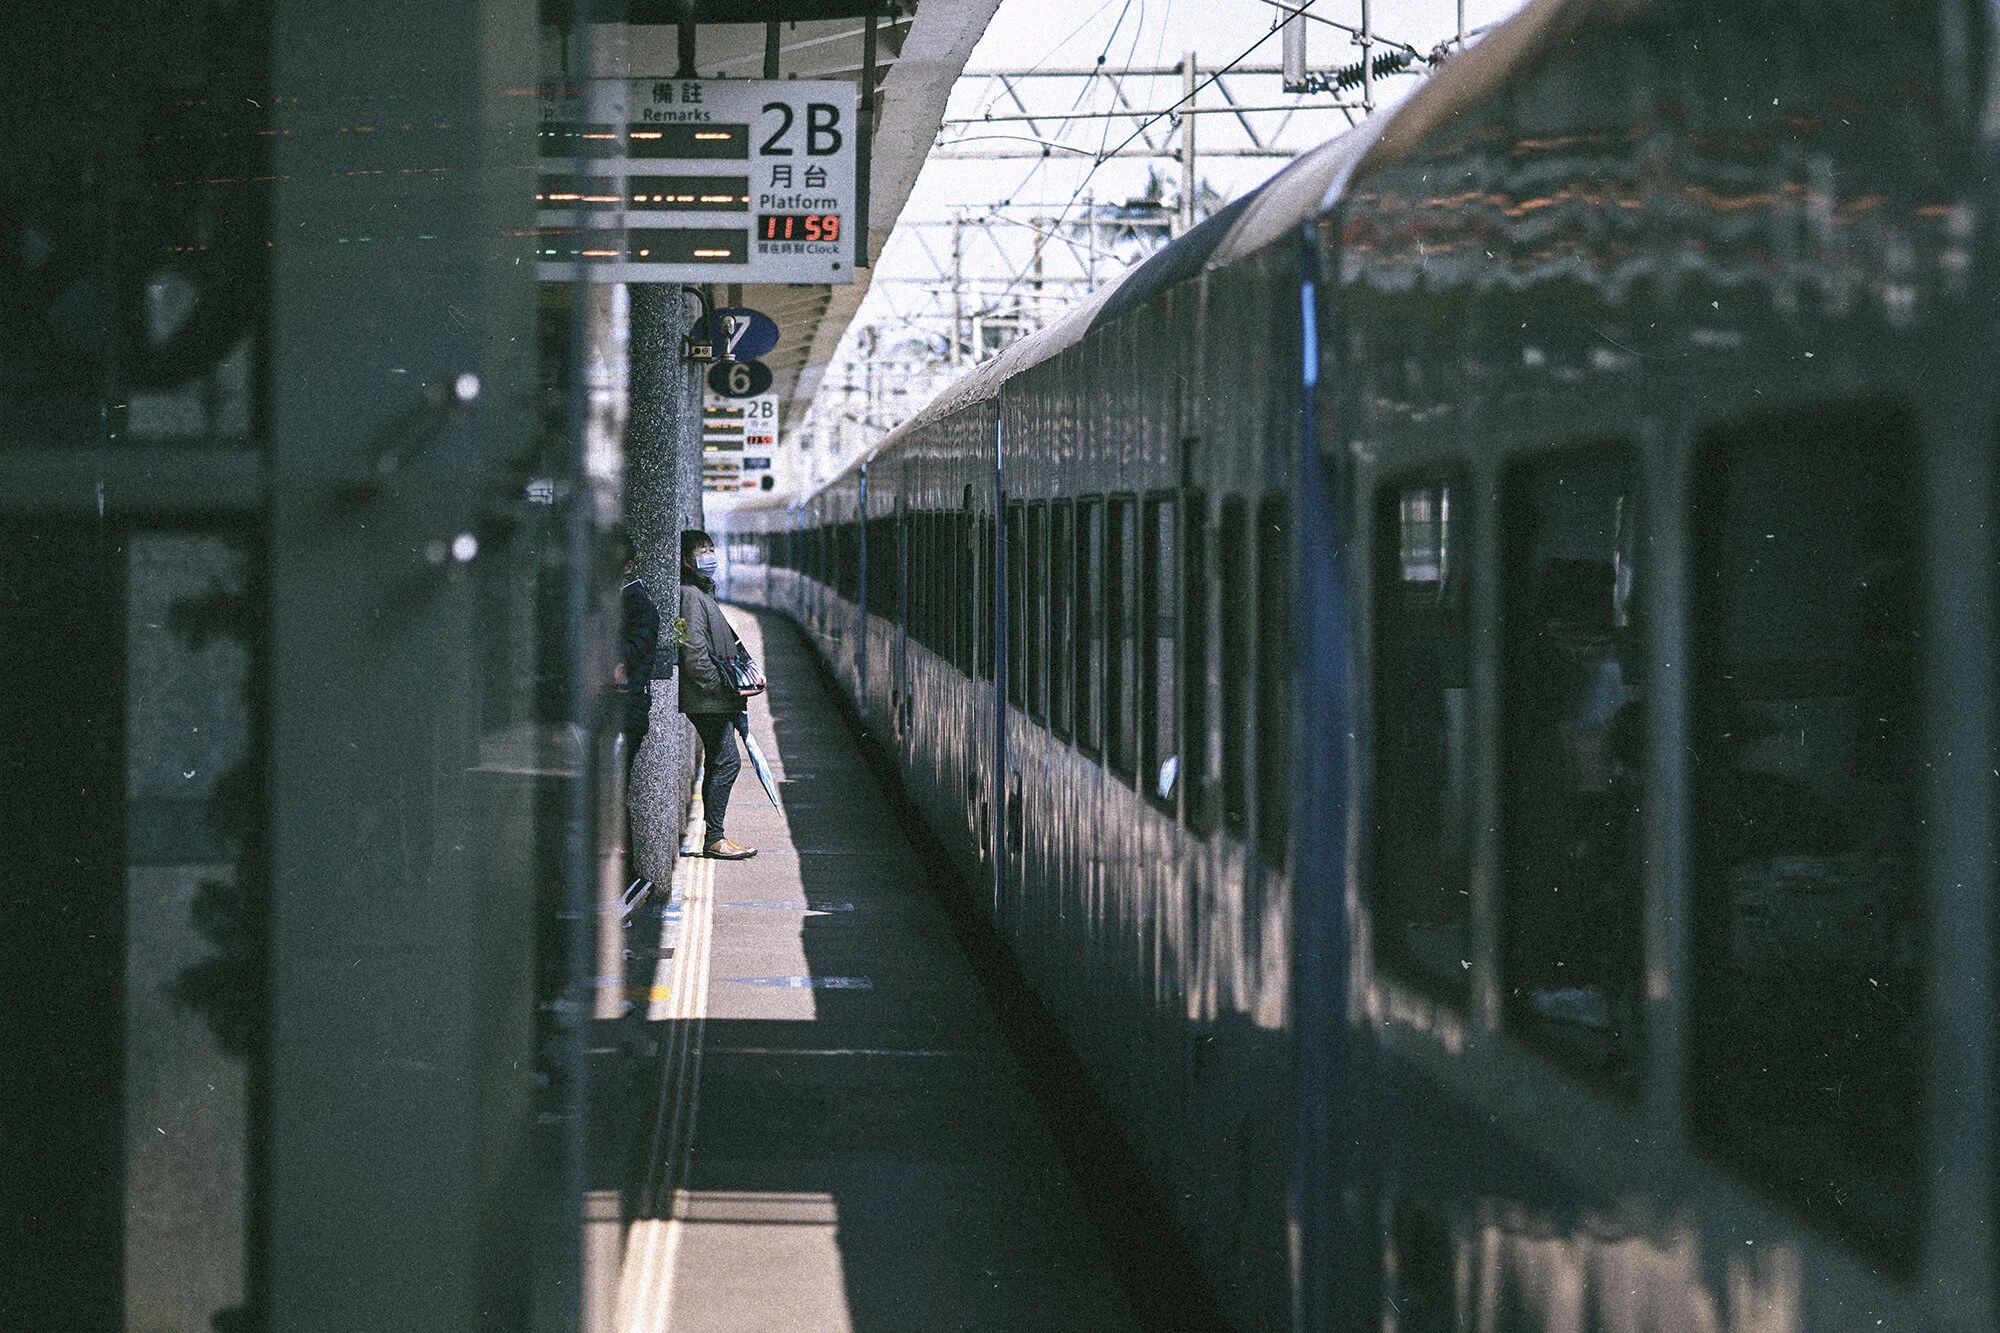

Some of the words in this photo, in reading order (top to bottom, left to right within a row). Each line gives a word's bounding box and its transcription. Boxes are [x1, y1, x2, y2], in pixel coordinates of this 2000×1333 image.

[653, 82, 703, 104] 備註
[643, 108, 711, 121] Remarks
[760, 102, 842, 156] 2B
[770, 164, 828, 188] 月台
[760, 194, 837, 209] Platform
[806, 243, 839, 254] Clock
[723, 316, 750, 354] 7
[730, 363, 750, 393] 6
[748, 401, 773, 418] 2B
